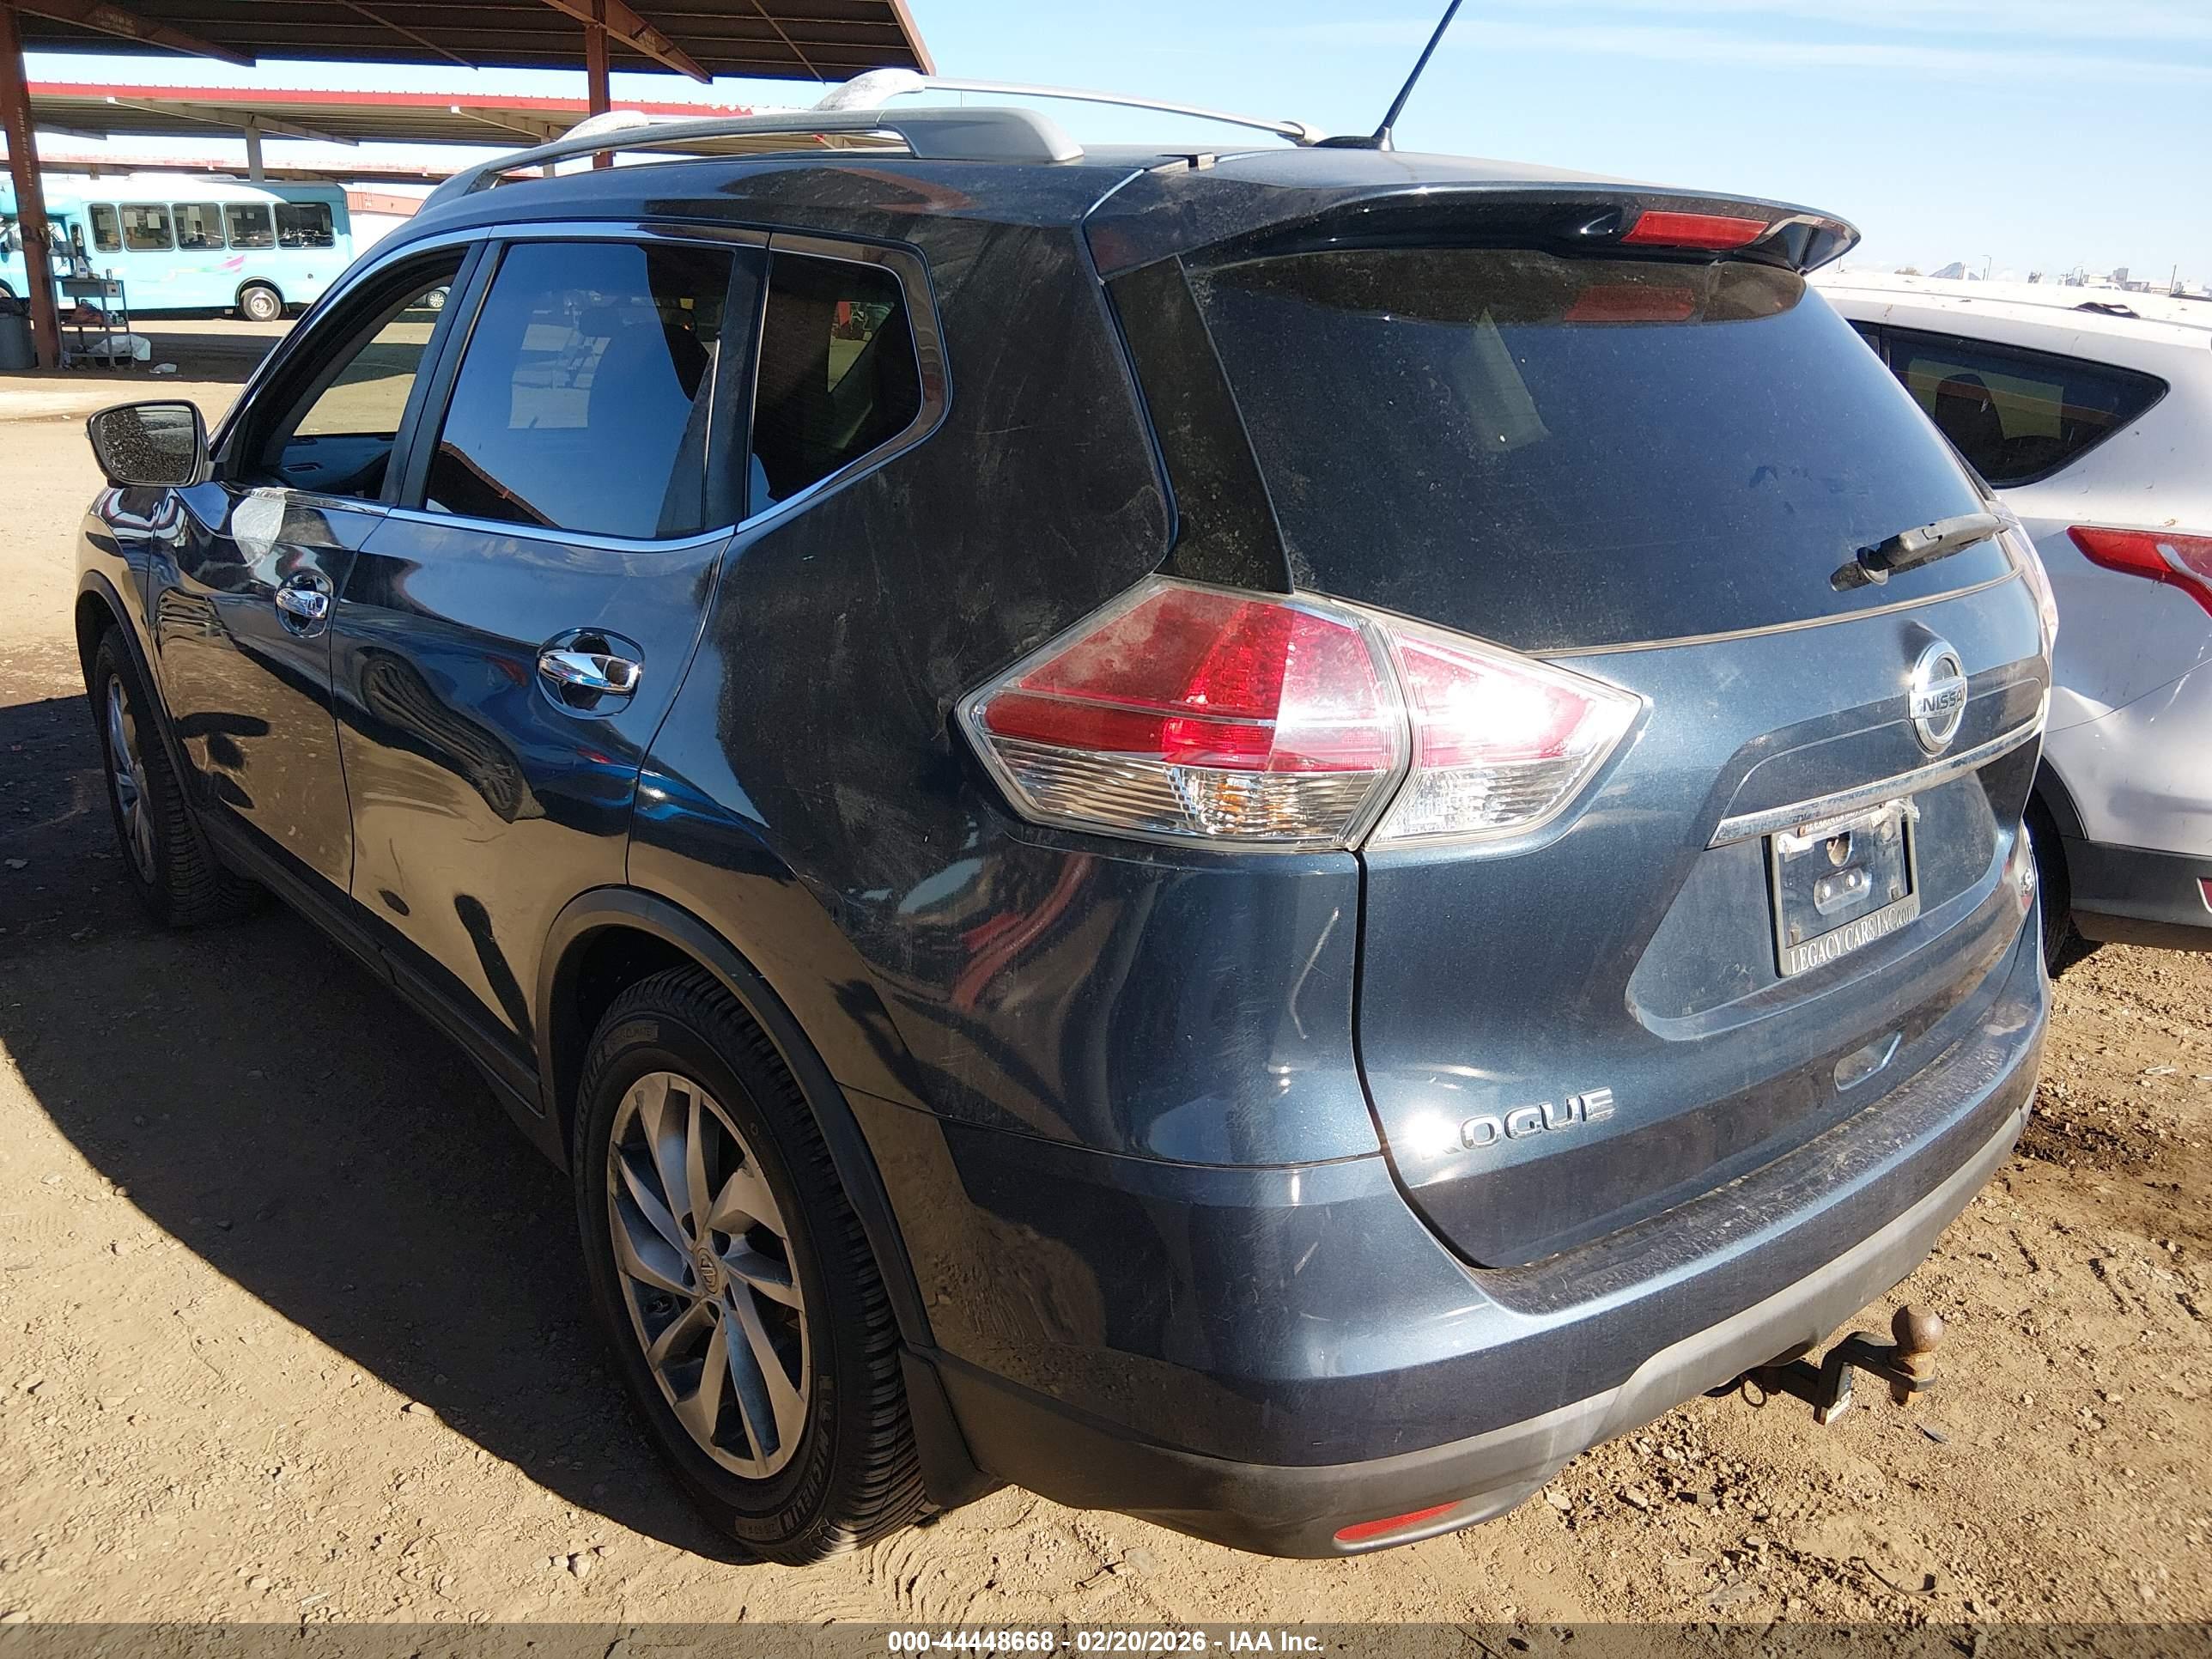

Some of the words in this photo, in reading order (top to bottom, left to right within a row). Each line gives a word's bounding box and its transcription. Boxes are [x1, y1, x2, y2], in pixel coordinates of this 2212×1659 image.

[1790, 930, 1844, 975] LEGACY
[1844, 917, 1875, 951] CARS
[1424, 1085, 1615, 1158] OGUE
